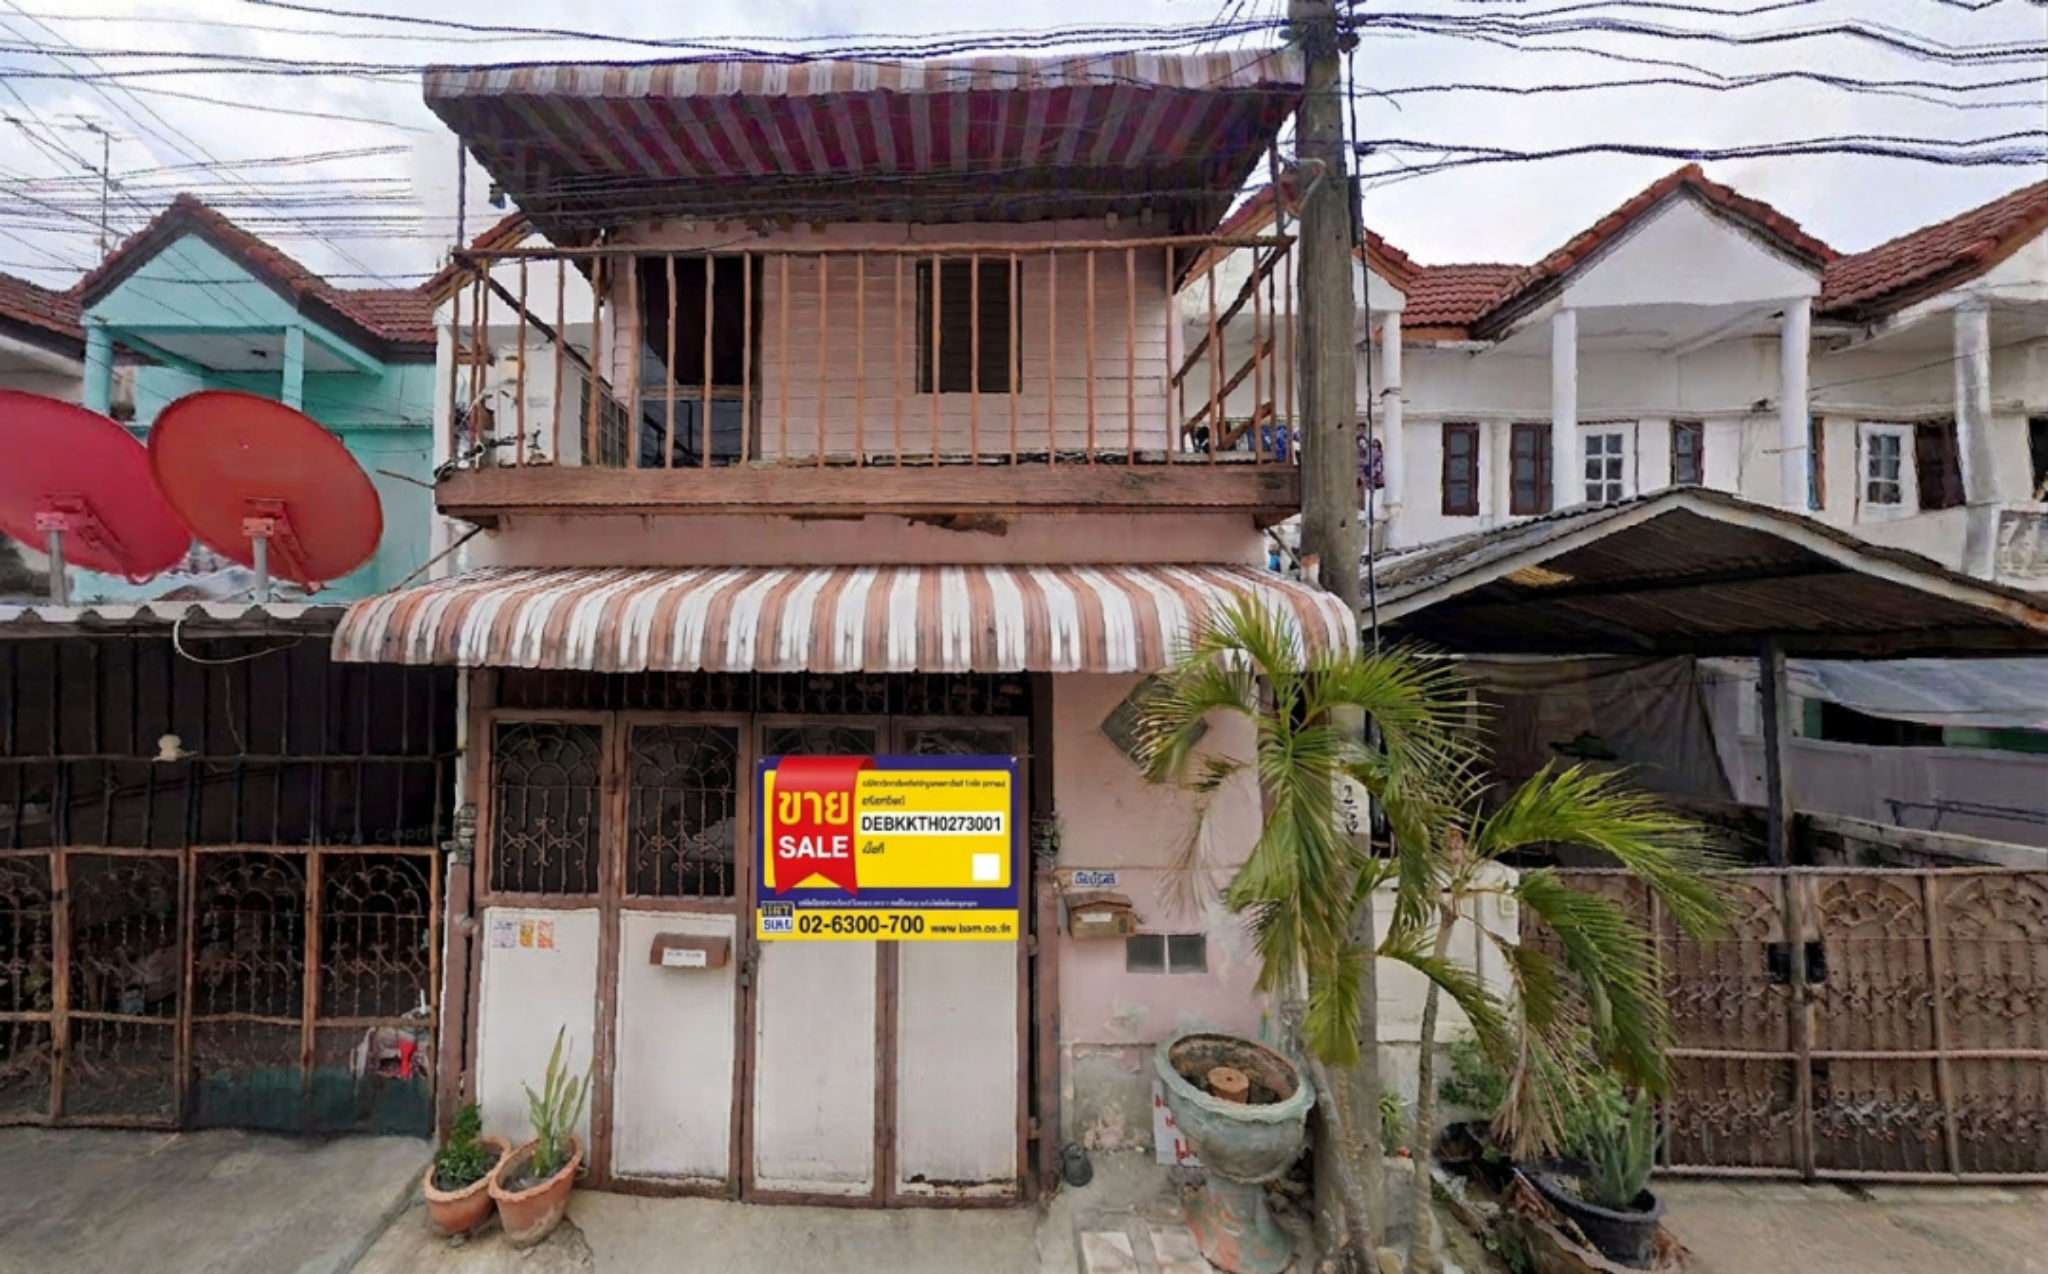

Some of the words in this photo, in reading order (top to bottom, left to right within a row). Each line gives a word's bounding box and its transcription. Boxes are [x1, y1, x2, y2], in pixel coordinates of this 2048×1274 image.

[778, 791, 849, 826] ขาย
[861, 816, 1001, 831] DEBKKTH0273001
[778, 835, 849, 858] SALE
[799, 915, 925, 934] 02-6300-700
